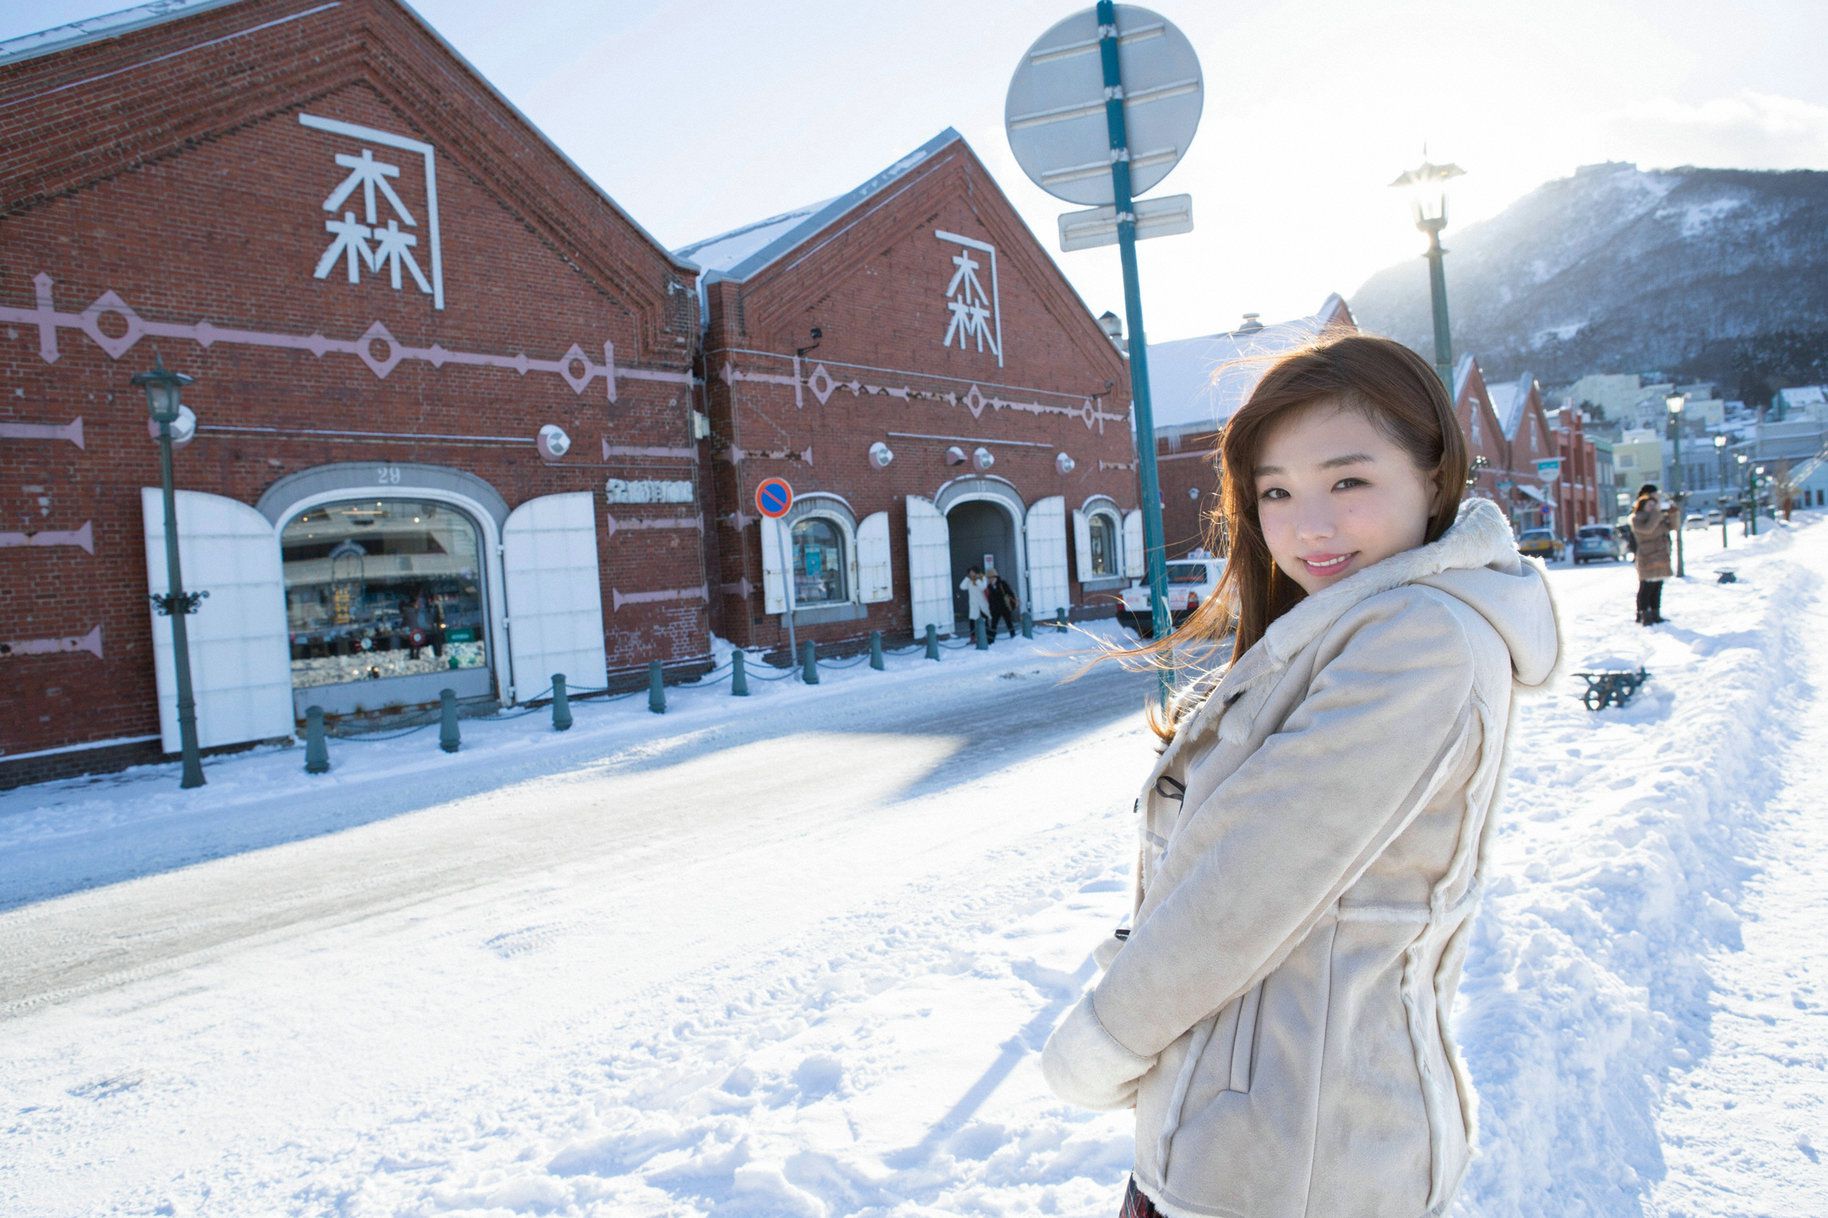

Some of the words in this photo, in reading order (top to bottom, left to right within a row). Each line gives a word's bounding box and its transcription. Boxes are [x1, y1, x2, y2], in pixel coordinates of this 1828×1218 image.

[313, 149, 433, 294] 森
[943, 249, 998, 355] 森
[377, 467, 401, 484] 29
